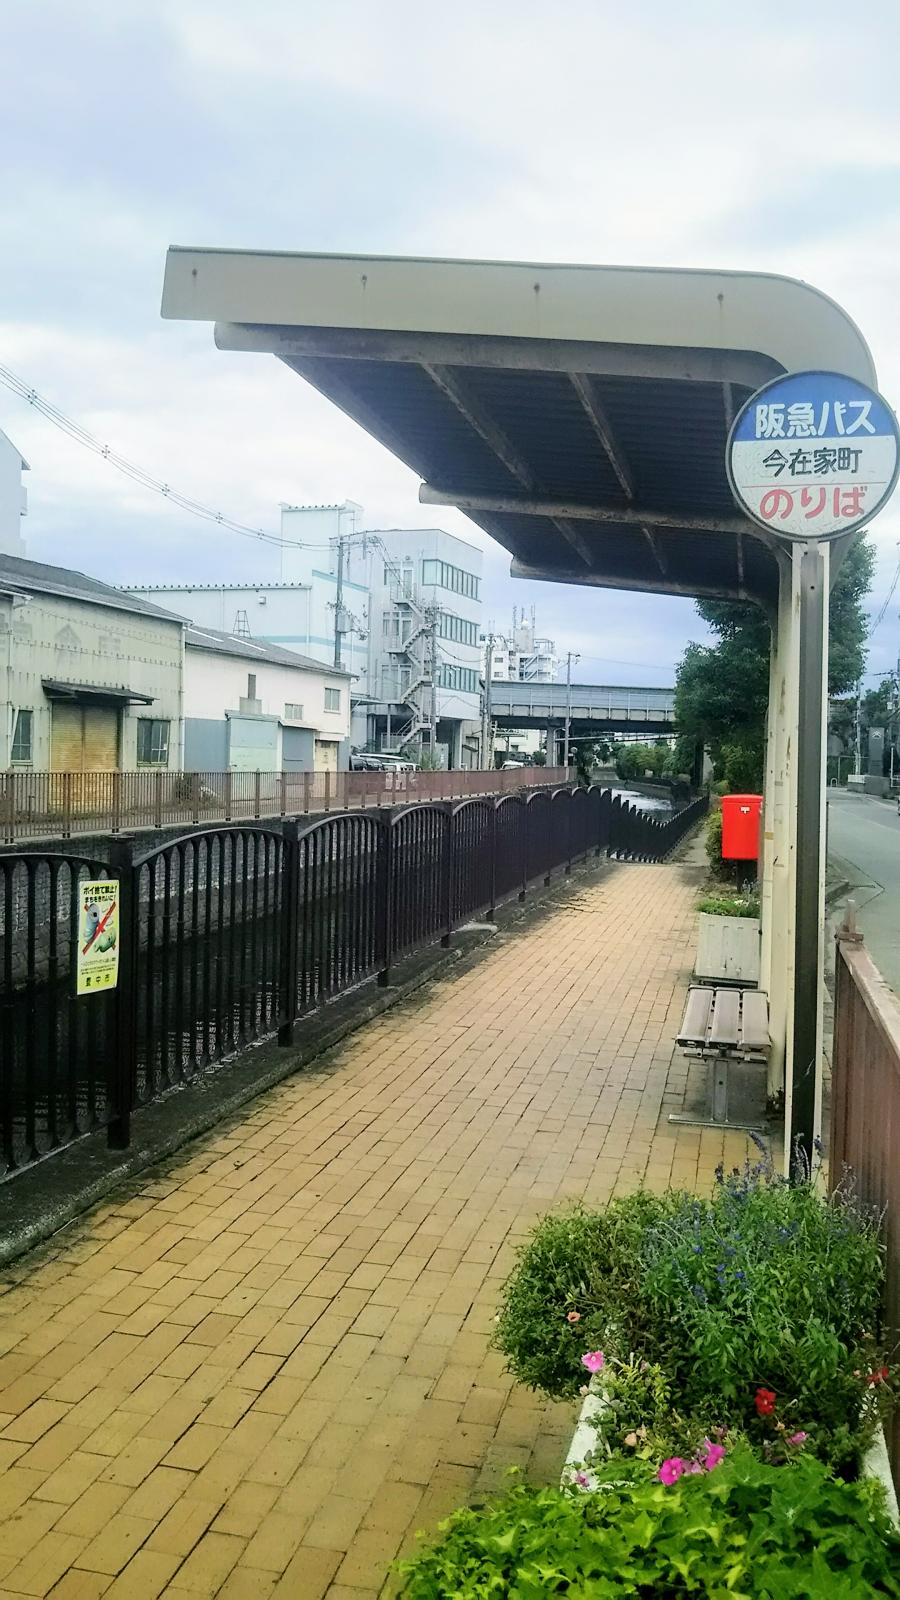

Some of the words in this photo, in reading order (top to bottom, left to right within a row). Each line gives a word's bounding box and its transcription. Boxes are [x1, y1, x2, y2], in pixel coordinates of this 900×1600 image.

[755, 401, 876, 438] 阪急バス
[763, 447, 862, 477] 今在家町
[760, 486, 868, 519] のりば
